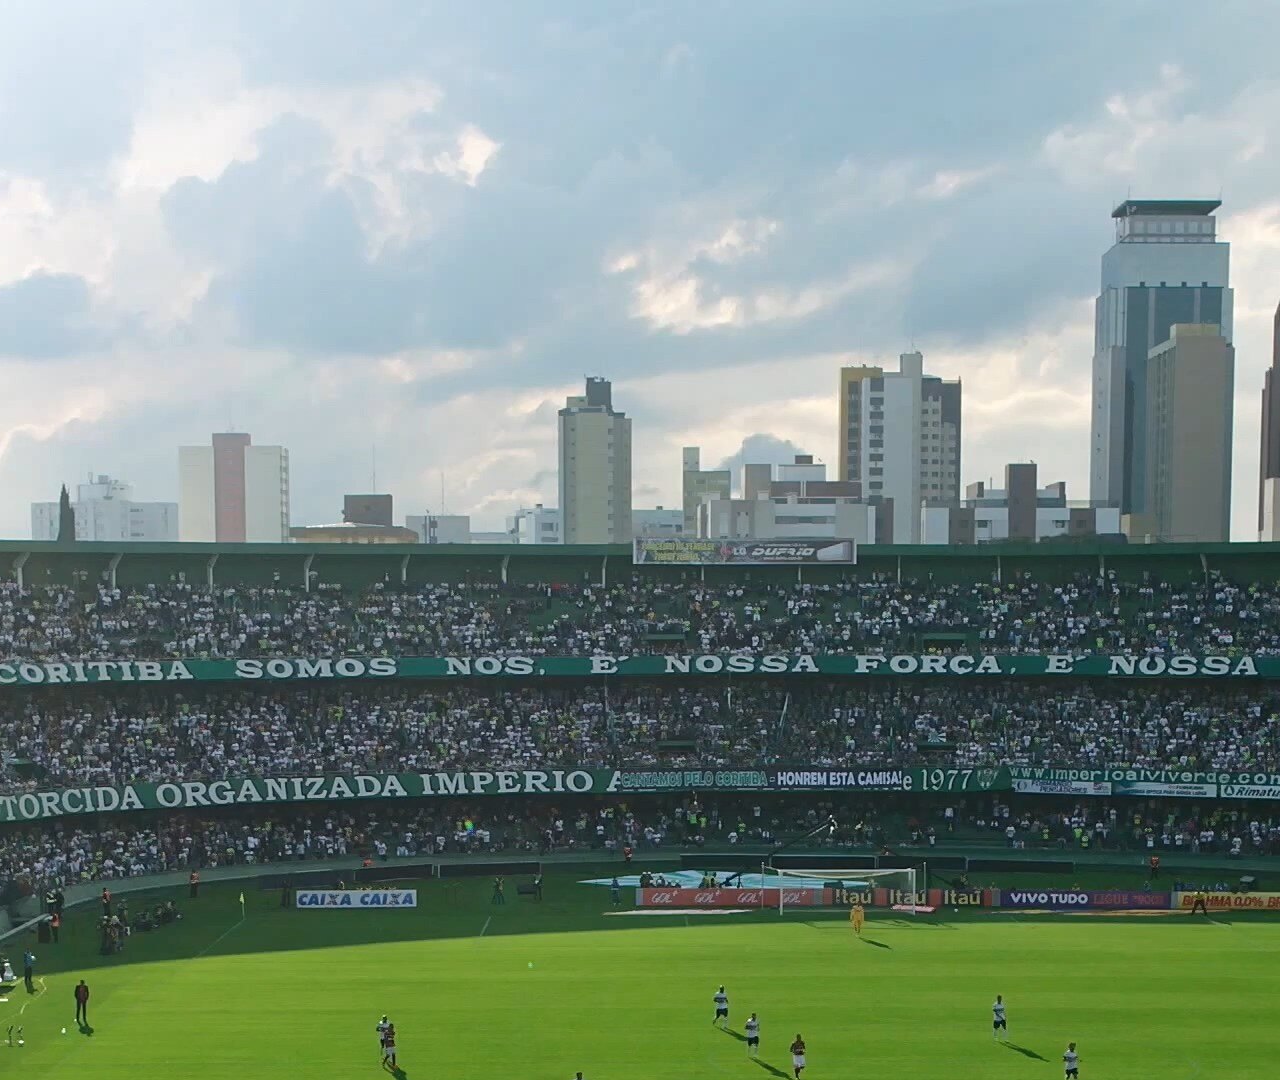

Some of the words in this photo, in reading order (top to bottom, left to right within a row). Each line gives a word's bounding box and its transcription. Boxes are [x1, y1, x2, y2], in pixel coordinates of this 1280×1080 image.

[733, 547, 747, 555] LG
[235, 657, 397, 679] SOMOS
[665, 655, 819, 674] NOSSA
[1107, 656, 1259, 676] NOSSA
[622, 772, 682, 787] CANTAMOS
[684, 772, 713, 787] PELO
[716, 771, 768, 787] CORITIBA
[777, 772, 827, 786] HONREM
[829, 772, 856, 786] ESTA
[858, 771, 902, 785] CAMISA!
[921, 768, 973, 791] 1977
[0, 785, 144, 821] TORCIDA
[156, 775, 407, 808] ORGANIZADA
[298, 892, 352, 906] CAIXA
[360, 892, 414, 906] CAIXA
[834, 888, 872, 904] Itaú
[890, 889, 926, 905] Itaú
[944, 889, 981, 905] Itaú
[1010, 893, 1048, 904] VIVO
[1050, 893, 1089, 904] TUDO
[1183, 895, 1232, 907] BHMA
